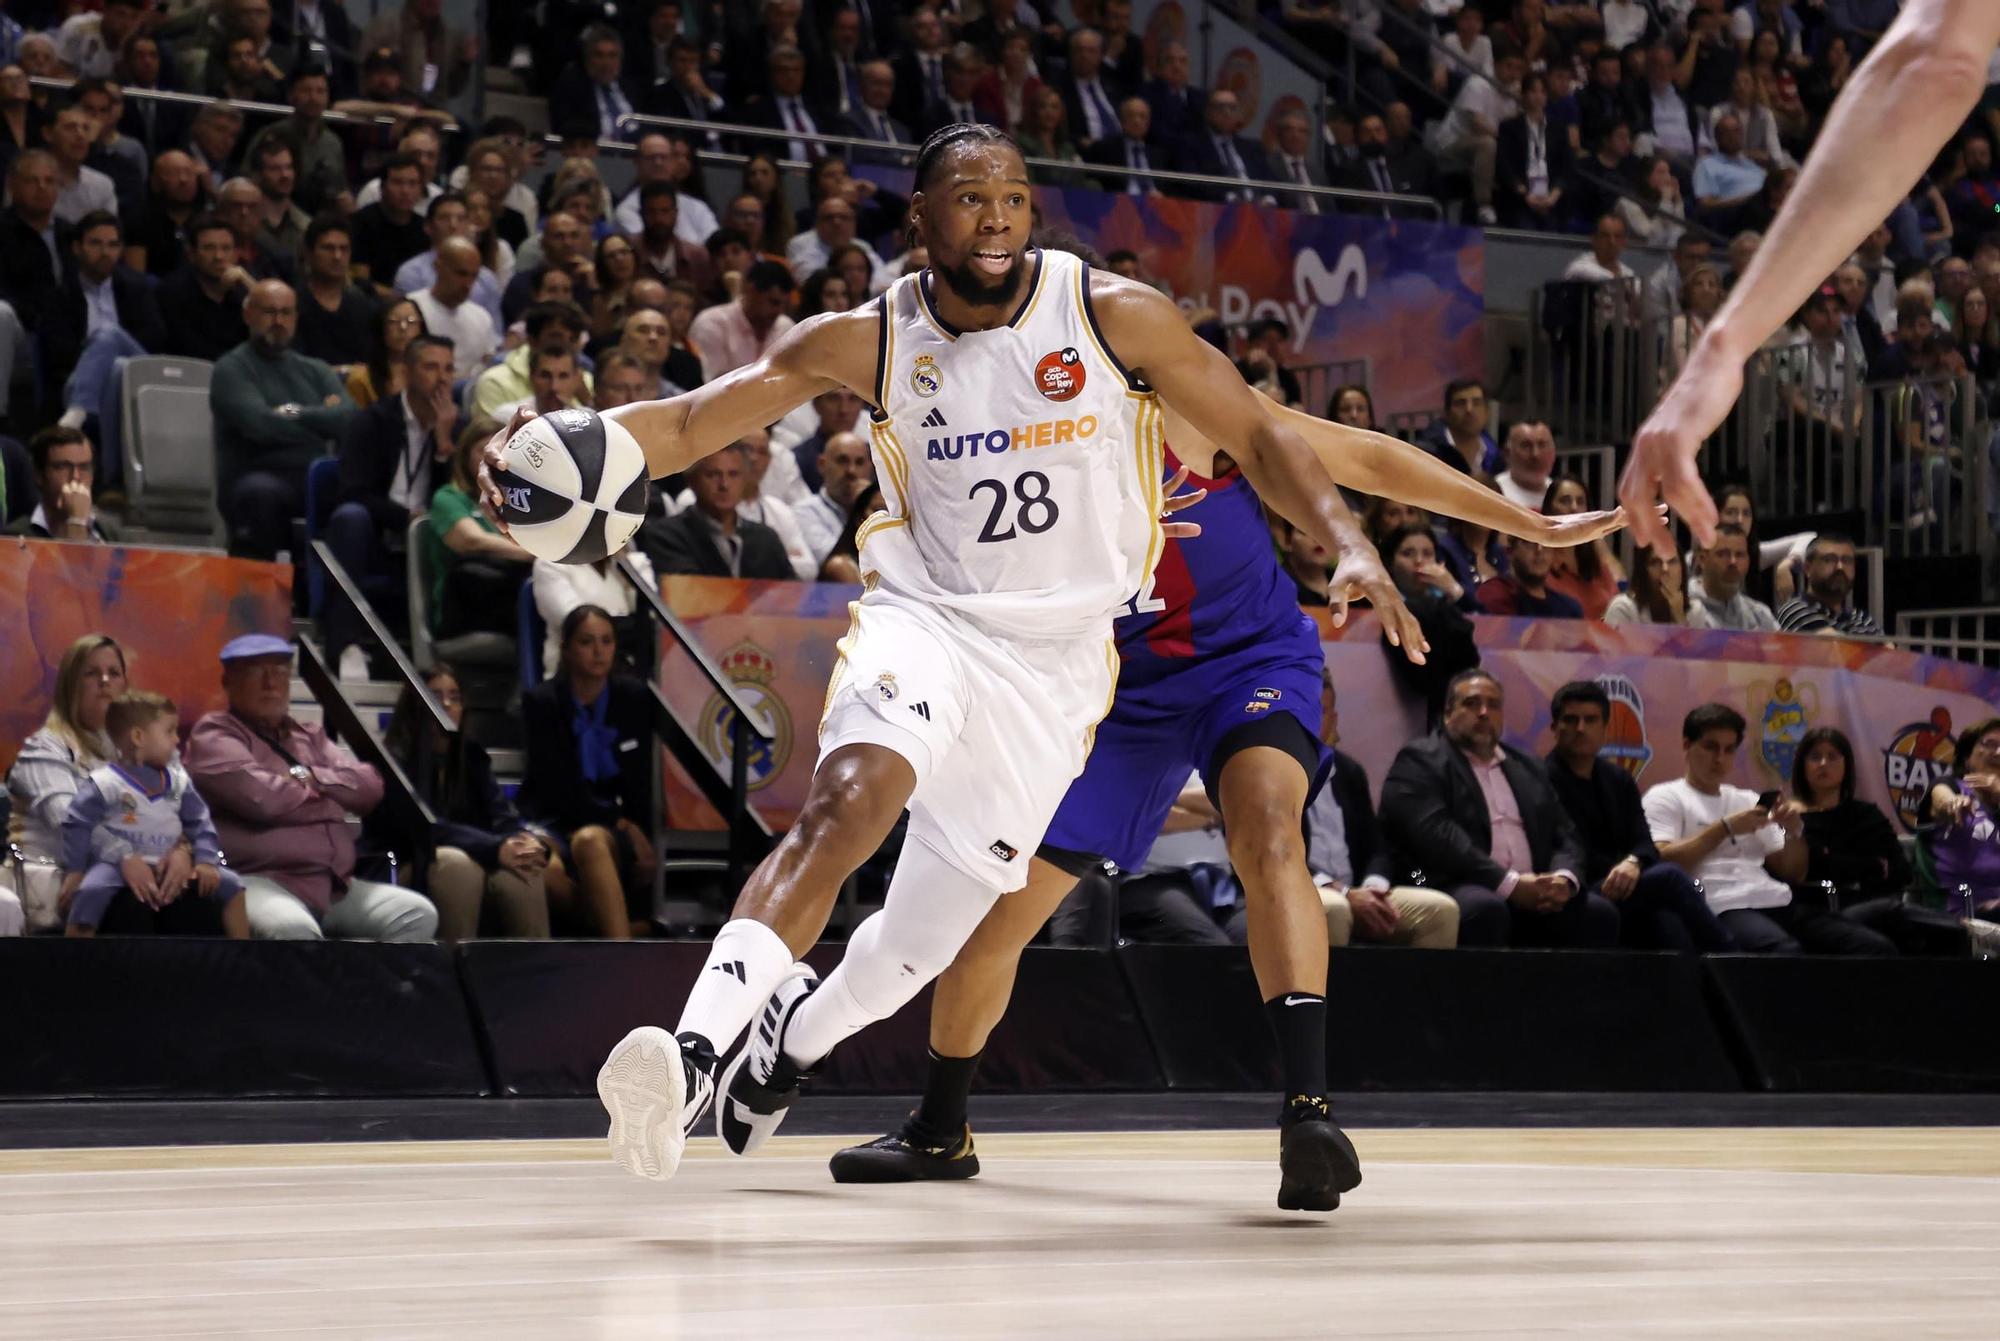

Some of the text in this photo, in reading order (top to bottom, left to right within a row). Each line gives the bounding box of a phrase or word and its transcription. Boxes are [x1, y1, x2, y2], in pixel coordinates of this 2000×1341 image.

[1043, 371, 1069, 382] Copa
[927, 415, 1097, 461] AUTOHERO
[969, 470, 1059, 543] 28
